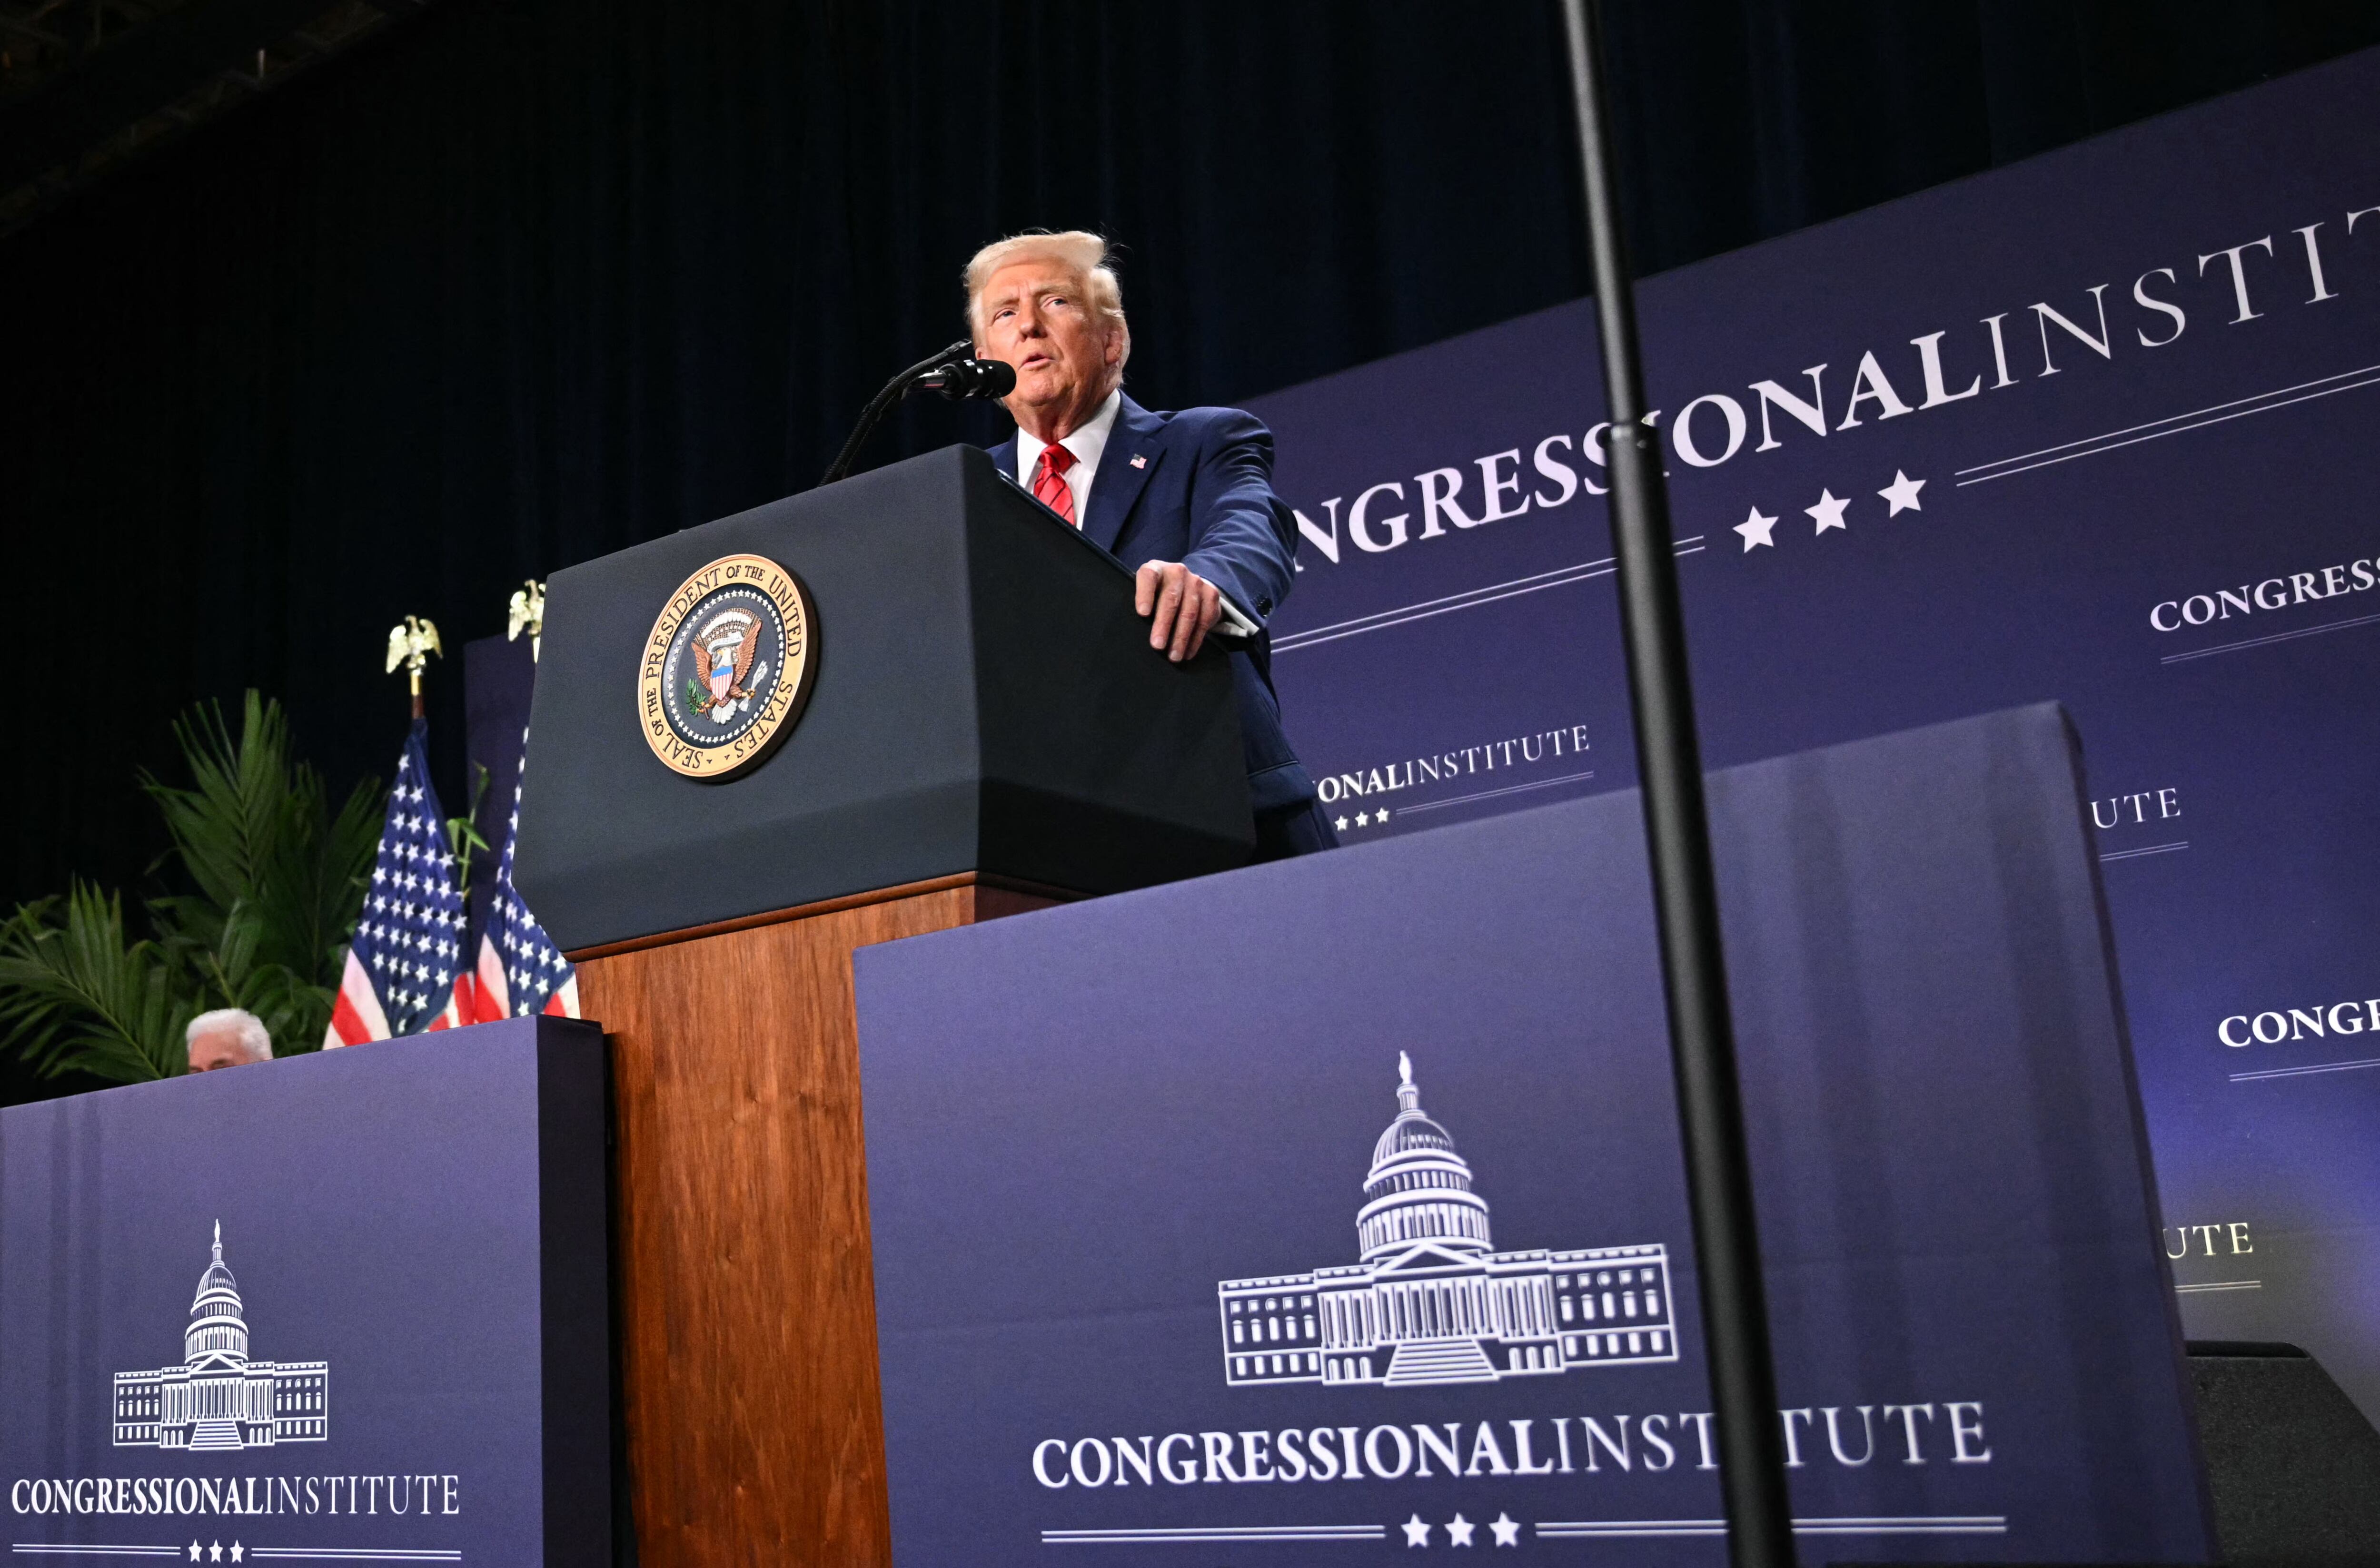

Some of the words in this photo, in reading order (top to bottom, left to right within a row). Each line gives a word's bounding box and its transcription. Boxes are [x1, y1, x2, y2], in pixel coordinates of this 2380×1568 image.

[726, 564, 742, 579] OF
[744, 565, 765, 582] THE
[645, 568, 721, 680] PRESIDENT
[769, 574, 802, 658] UNITED
[646, 687, 658, 717] THE
[652, 717, 664, 737] OF
[734, 680, 793, 759] STATES
[663, 732, 704, 769] SEAL
